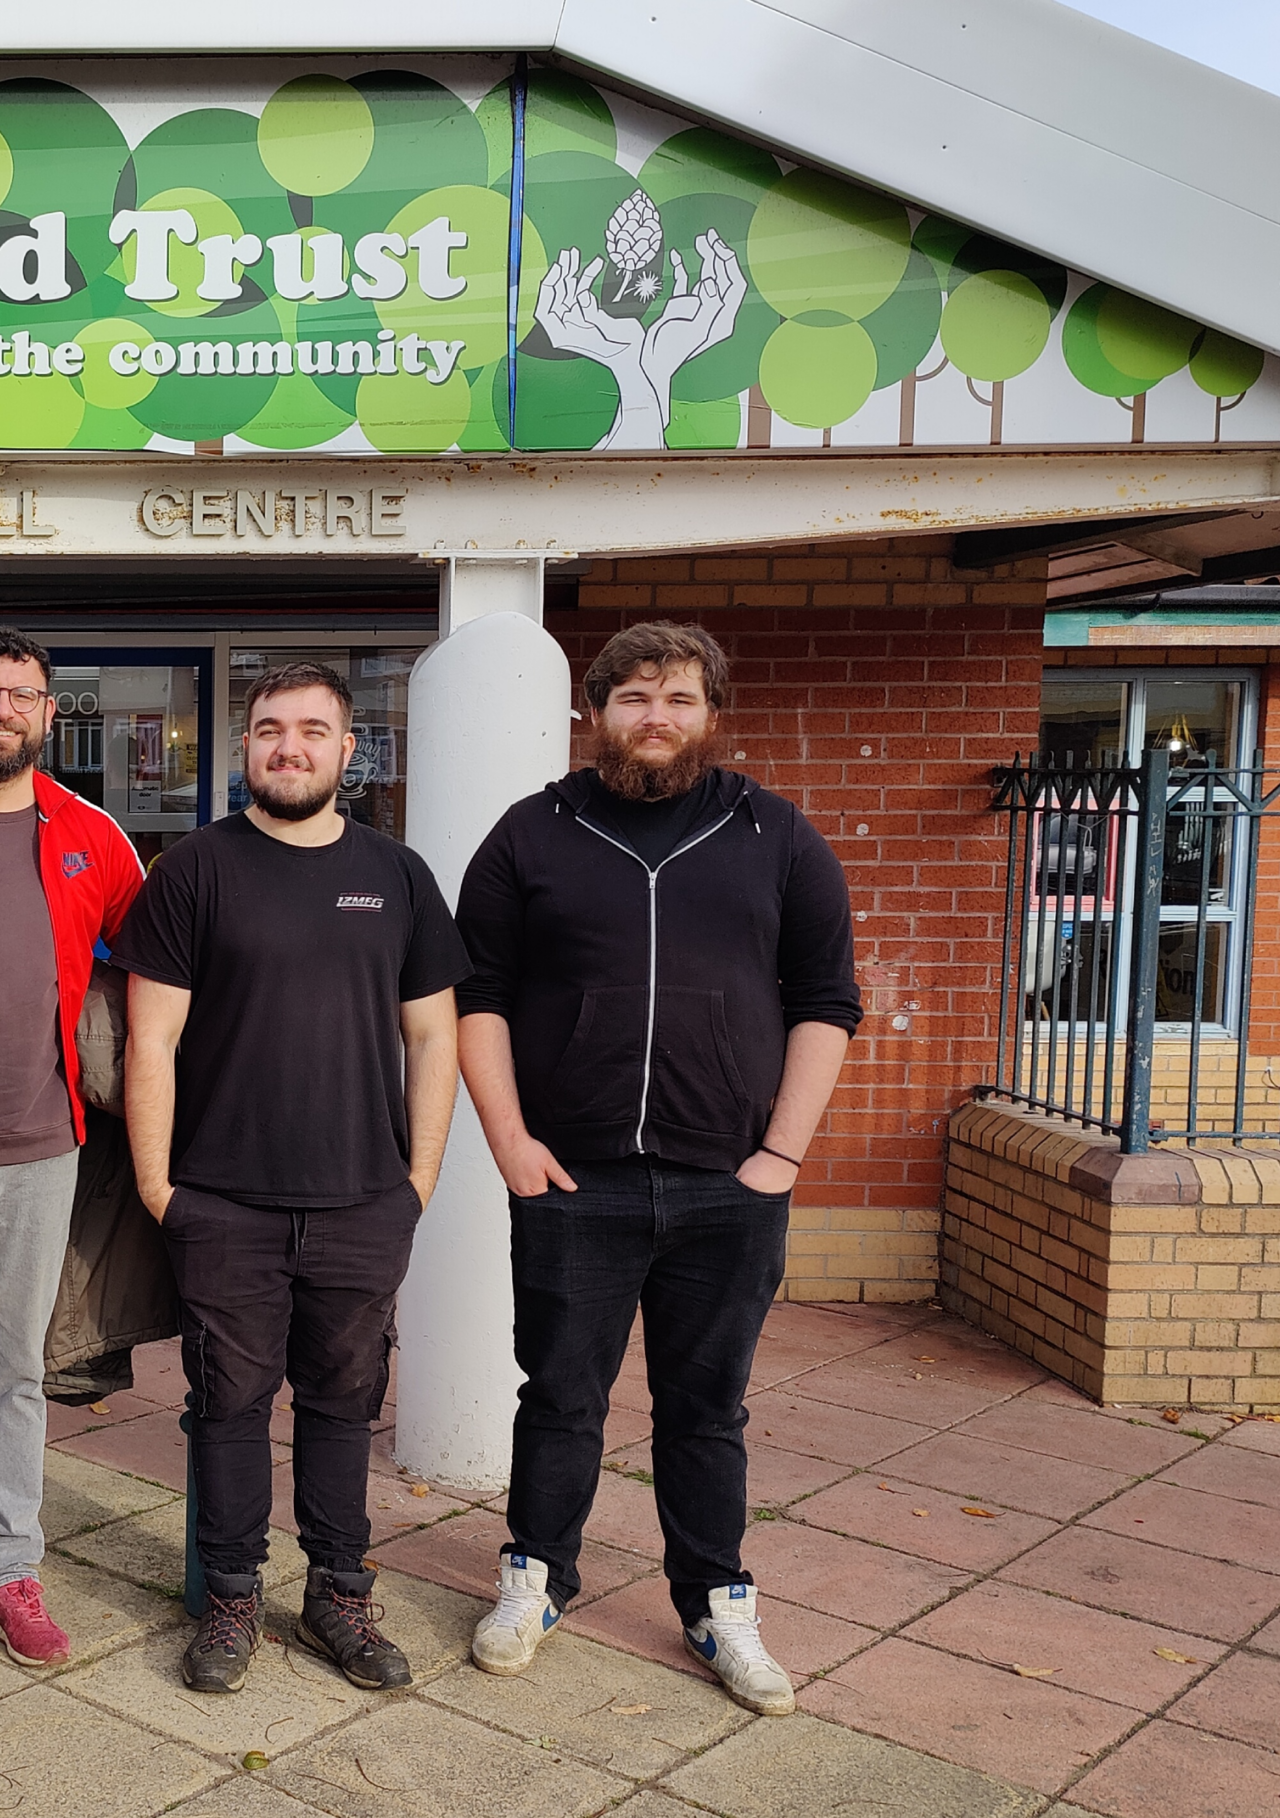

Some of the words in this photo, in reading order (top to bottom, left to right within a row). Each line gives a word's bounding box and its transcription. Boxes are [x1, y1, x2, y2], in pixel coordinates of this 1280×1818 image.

[109, 209, 469, 301] Trust
[108, 330, 466, 384] community
[141, 486, 408, 537] CENTRE
[62, 850, 90, 867] NIKE
